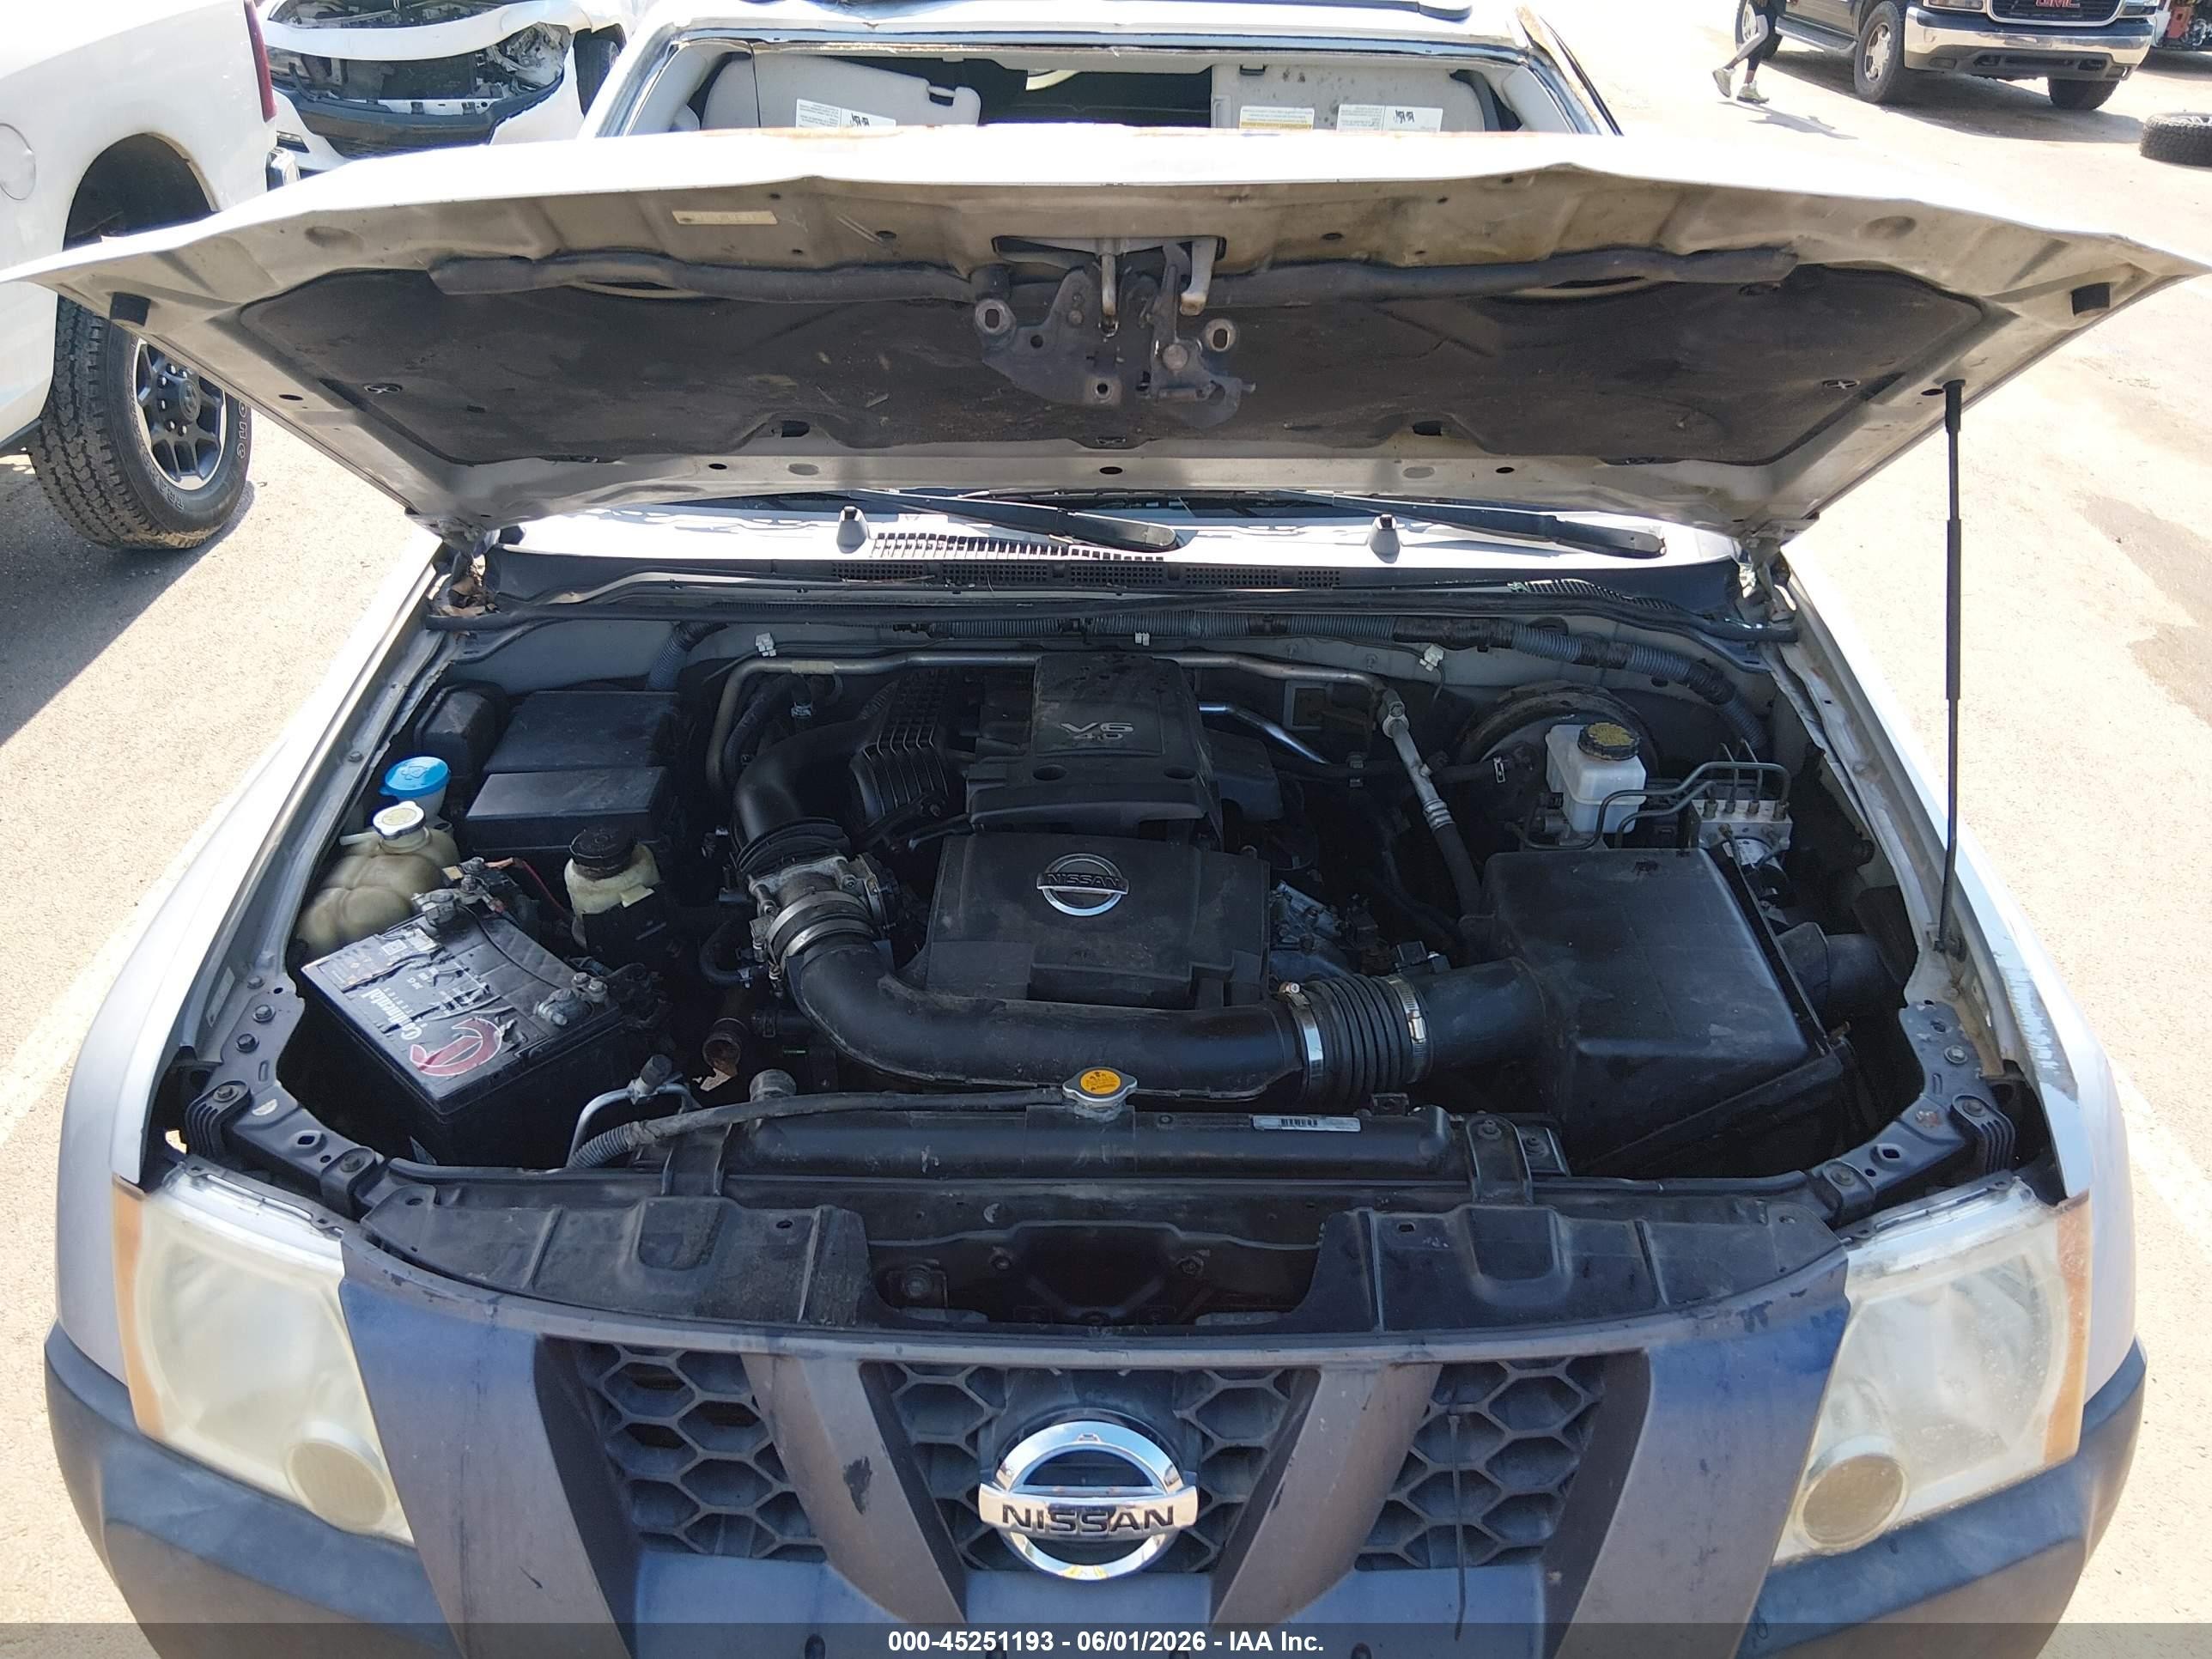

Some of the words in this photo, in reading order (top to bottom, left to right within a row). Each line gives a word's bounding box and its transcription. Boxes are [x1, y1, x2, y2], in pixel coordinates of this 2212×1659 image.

[1060, 722, 1134, 733] V6
[1047, 873, 1121, 889] NISSAN
[1001, 1504, 1175, 1533] NISSAN
